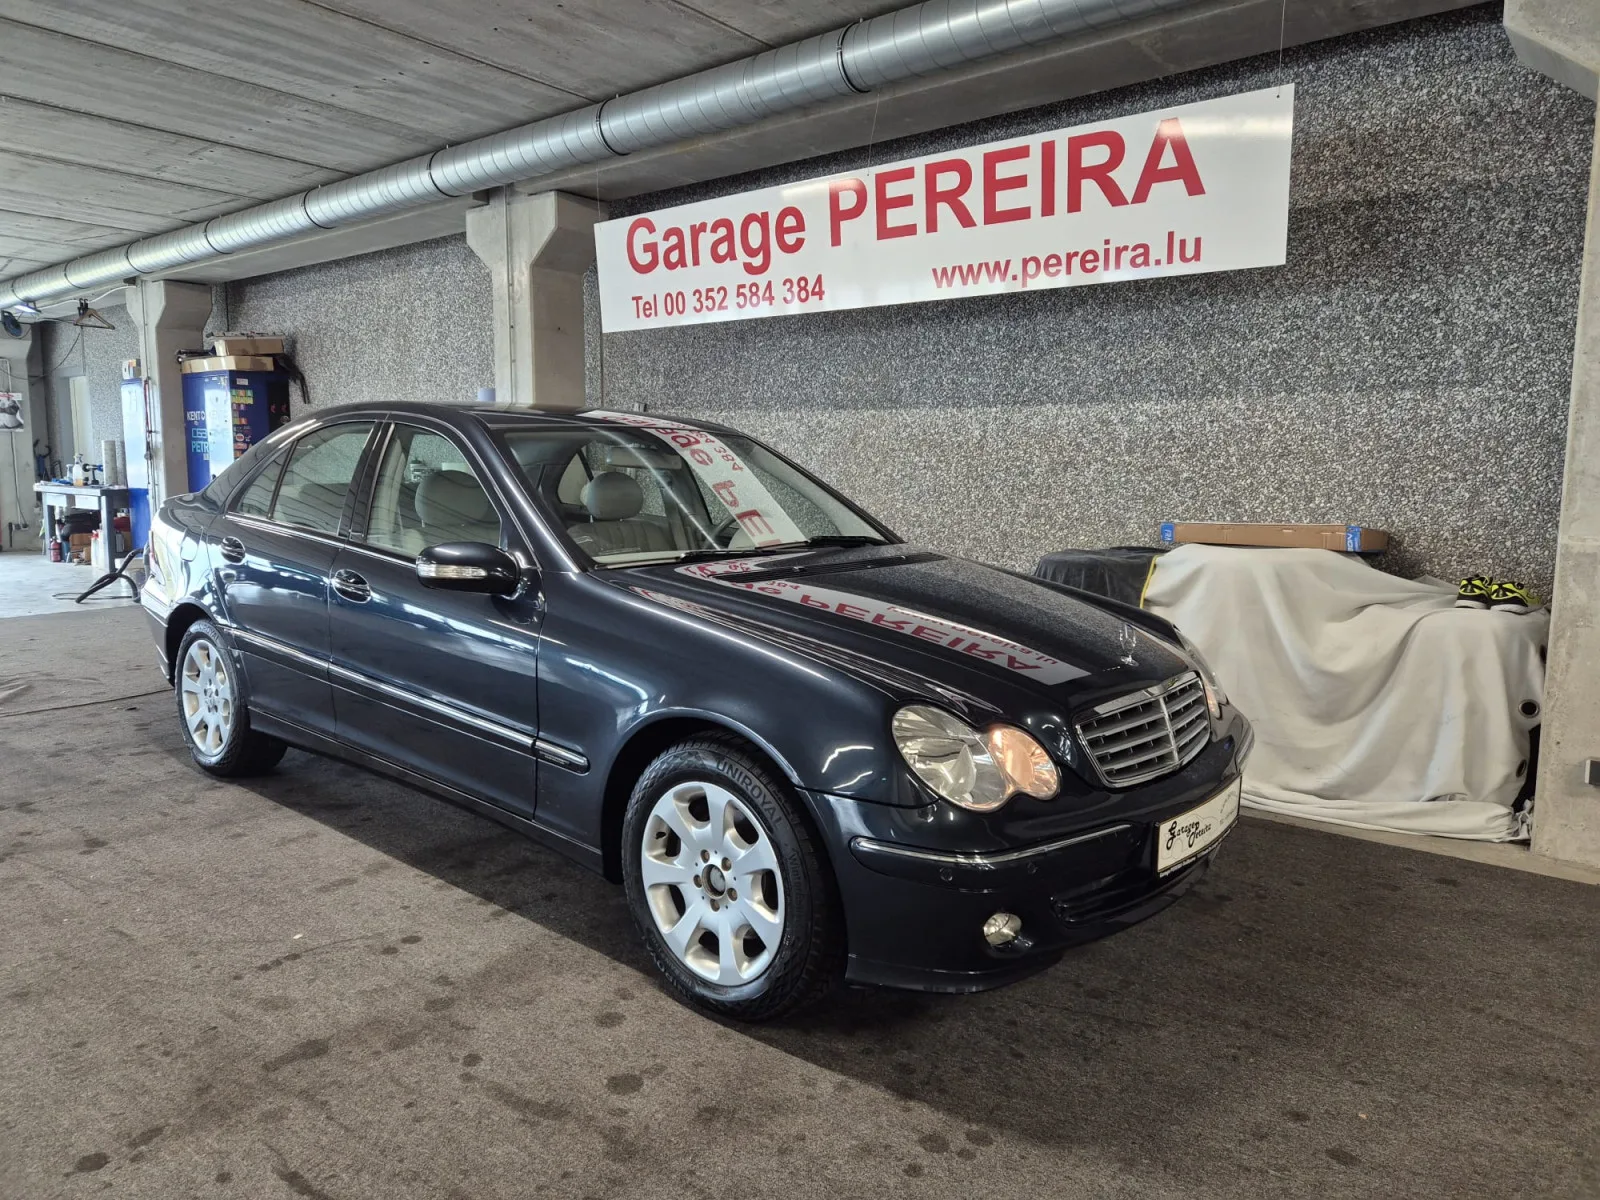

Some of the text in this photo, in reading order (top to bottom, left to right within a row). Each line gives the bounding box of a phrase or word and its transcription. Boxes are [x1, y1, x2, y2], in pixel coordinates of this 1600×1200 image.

[626, 116, 1207, 277] Garage PEREIRA
[931, 230, 1204, 290] www.pereira.lu
[631, 273, 826, 319] Tel 00 352 584 384
[716, 759, 785, 831] UNIROYAL
